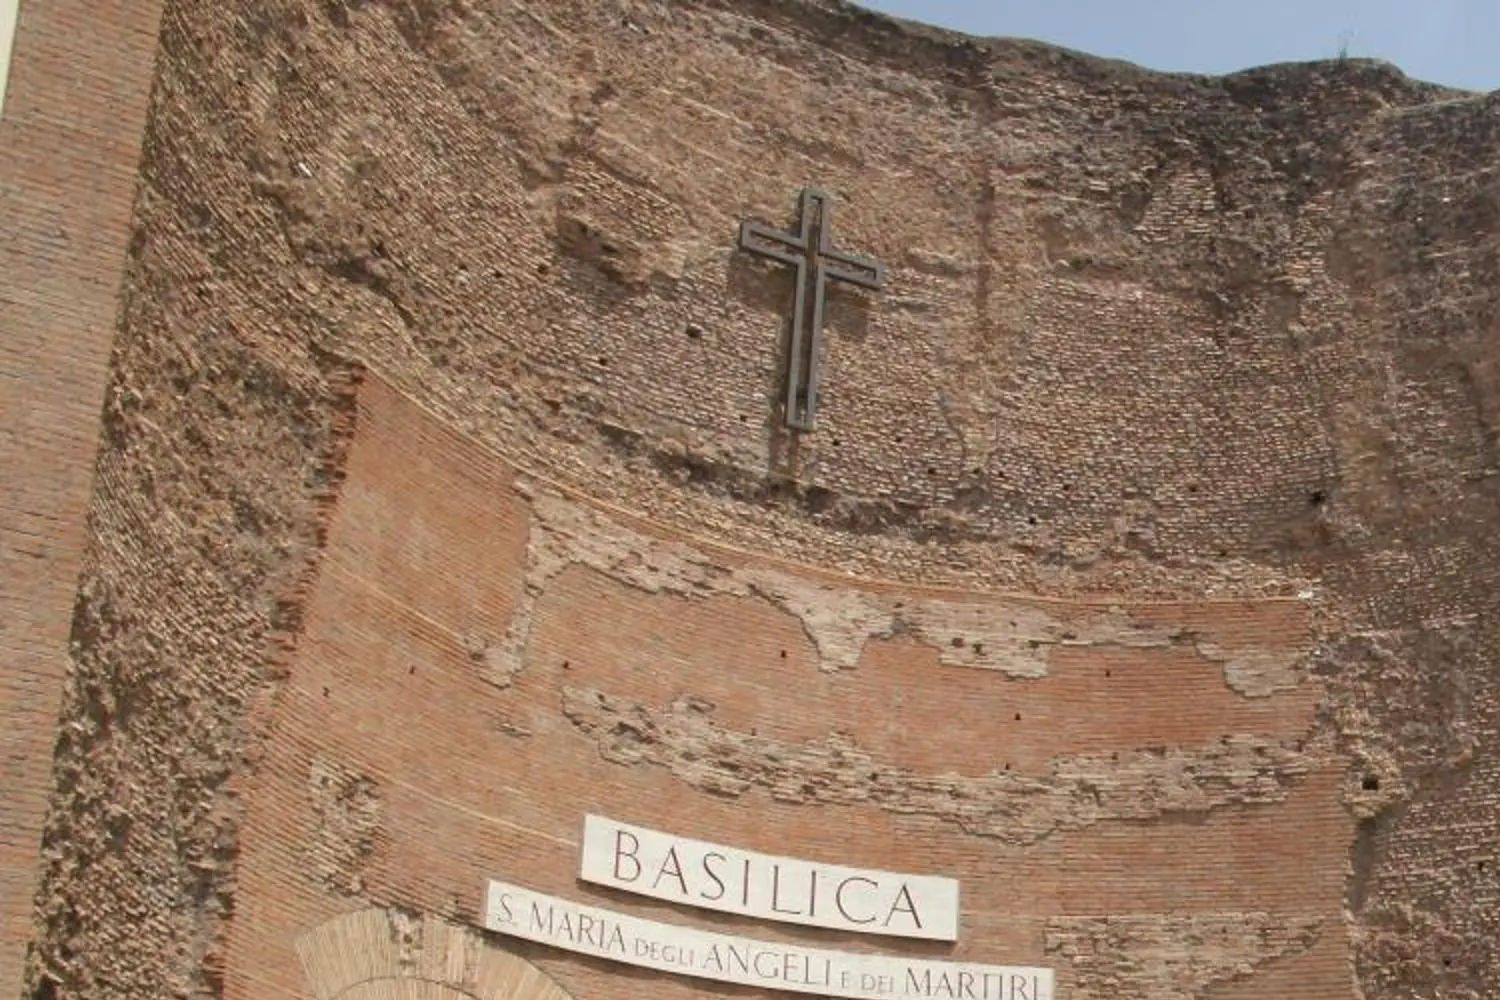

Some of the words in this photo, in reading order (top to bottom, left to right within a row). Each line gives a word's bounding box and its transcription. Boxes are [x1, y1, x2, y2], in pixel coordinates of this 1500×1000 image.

[612, 829, 923, 929] BASILICA
[529, 900, 626, 953] MARIA
[635, 937, 695, 966] DEGLI
[703, 944, 831, 987] ANGELI
[841, 970, 850, 989] E
[861, 973, 895, 993] DEI
